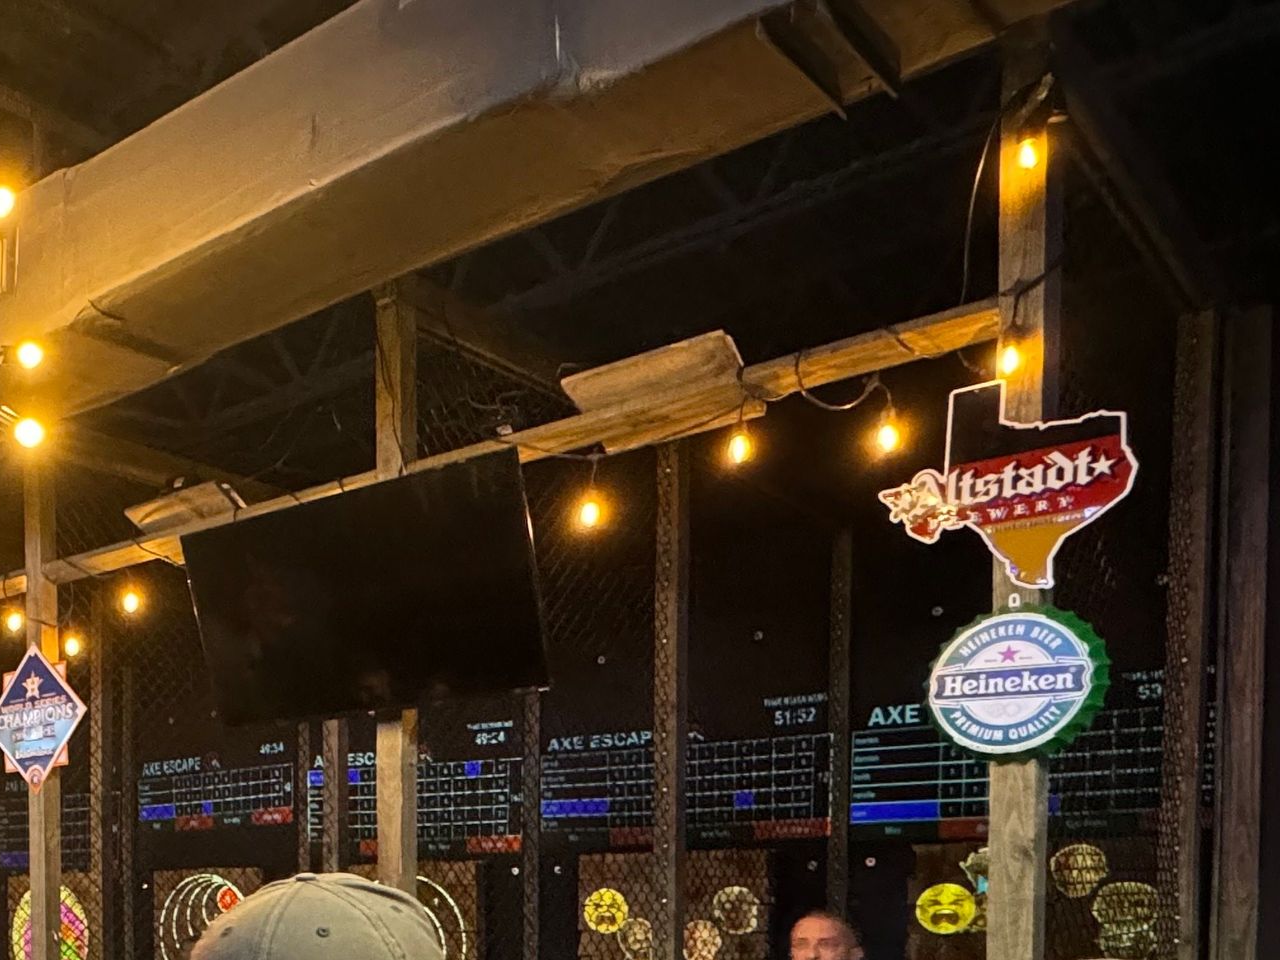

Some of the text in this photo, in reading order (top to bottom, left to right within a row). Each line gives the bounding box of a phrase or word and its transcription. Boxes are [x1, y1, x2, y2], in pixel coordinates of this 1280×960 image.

[916, 446, 1096, 507] Altstadt
[958, 623, 1063, 657] HEINEKEN BEER
[942, 671, 1074, 697] Heineken
[867, 703, 921, 727] AXE
[950, 705, 1061, 741] PREMIUM QUALITY
[547, 730, 653, 752] AXE ESCAP
[347, 751, 375, 767] ESC
